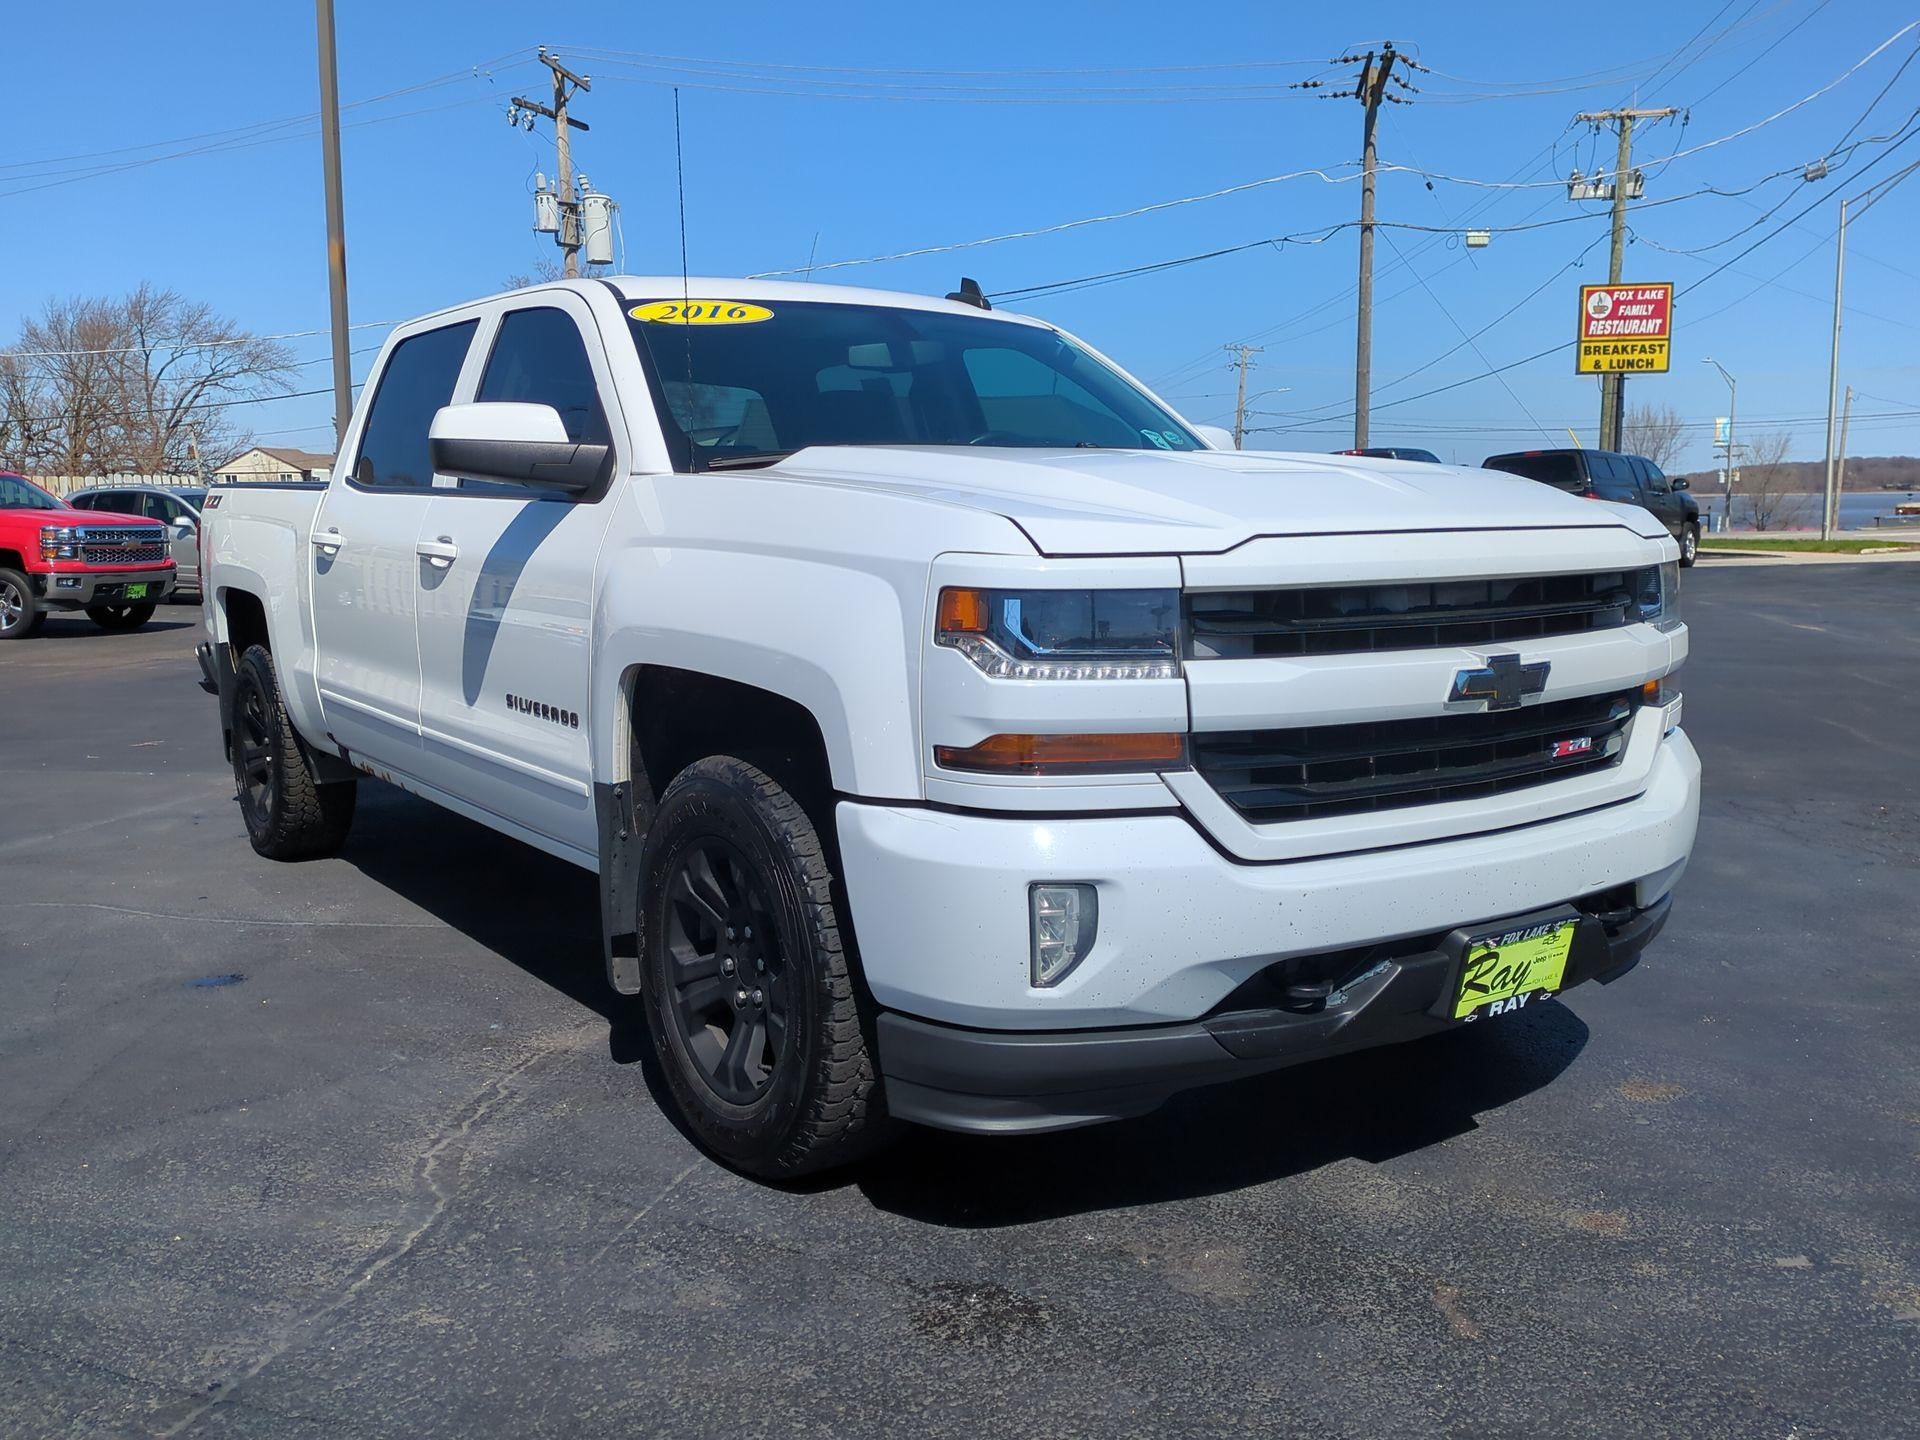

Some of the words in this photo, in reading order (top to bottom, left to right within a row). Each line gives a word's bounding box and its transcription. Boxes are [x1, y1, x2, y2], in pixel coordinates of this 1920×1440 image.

[1613, 290, 1634, 301] FOX
[1637, 290, 1665, 299] LAKE
[658, 305, 748, 319] 2016
[1618, 304, 1655, 316] FAMILY
[1588, 318, 1663, 335] RESTAURANT
[1583, 343, 1666, 356] BREAKFAST
[1593, 359, 1602, 370] &
[1609, 358, 1655, 369] LUNCH
[505, 693, 579, 730] SILVERADO
[1552, 737, 1592, 758] Z71
[1501, 932, 1522, 946] FOX
[1524, 923, 1551, 940] LAKE
[1460, 951, 1532, 1000] Ray
[1489, 992, 1532, 1017] RAY
